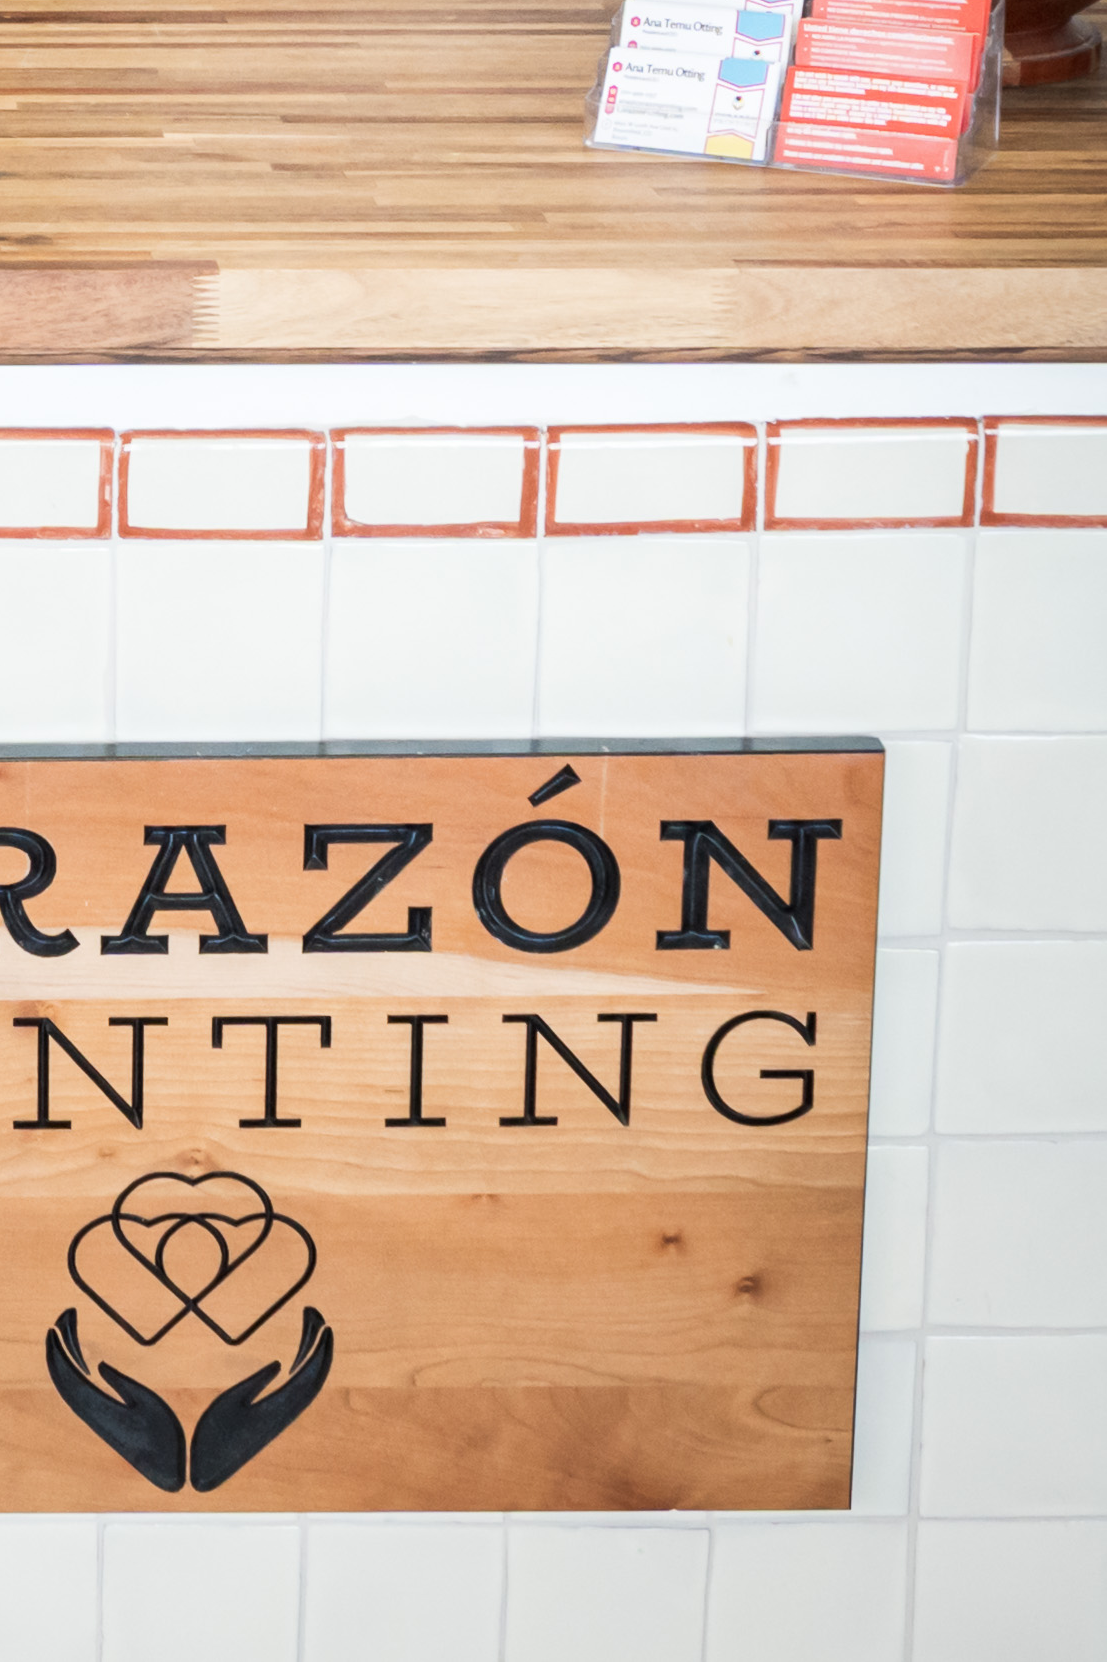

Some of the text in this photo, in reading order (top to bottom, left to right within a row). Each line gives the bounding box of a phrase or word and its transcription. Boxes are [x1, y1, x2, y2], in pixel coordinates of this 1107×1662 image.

[643, 17, 662, 28] Ana
[693, 21, 724, 36] Otting
[625, 62, 644, 73] Ana
[675, 66, 706, 82] Otting
